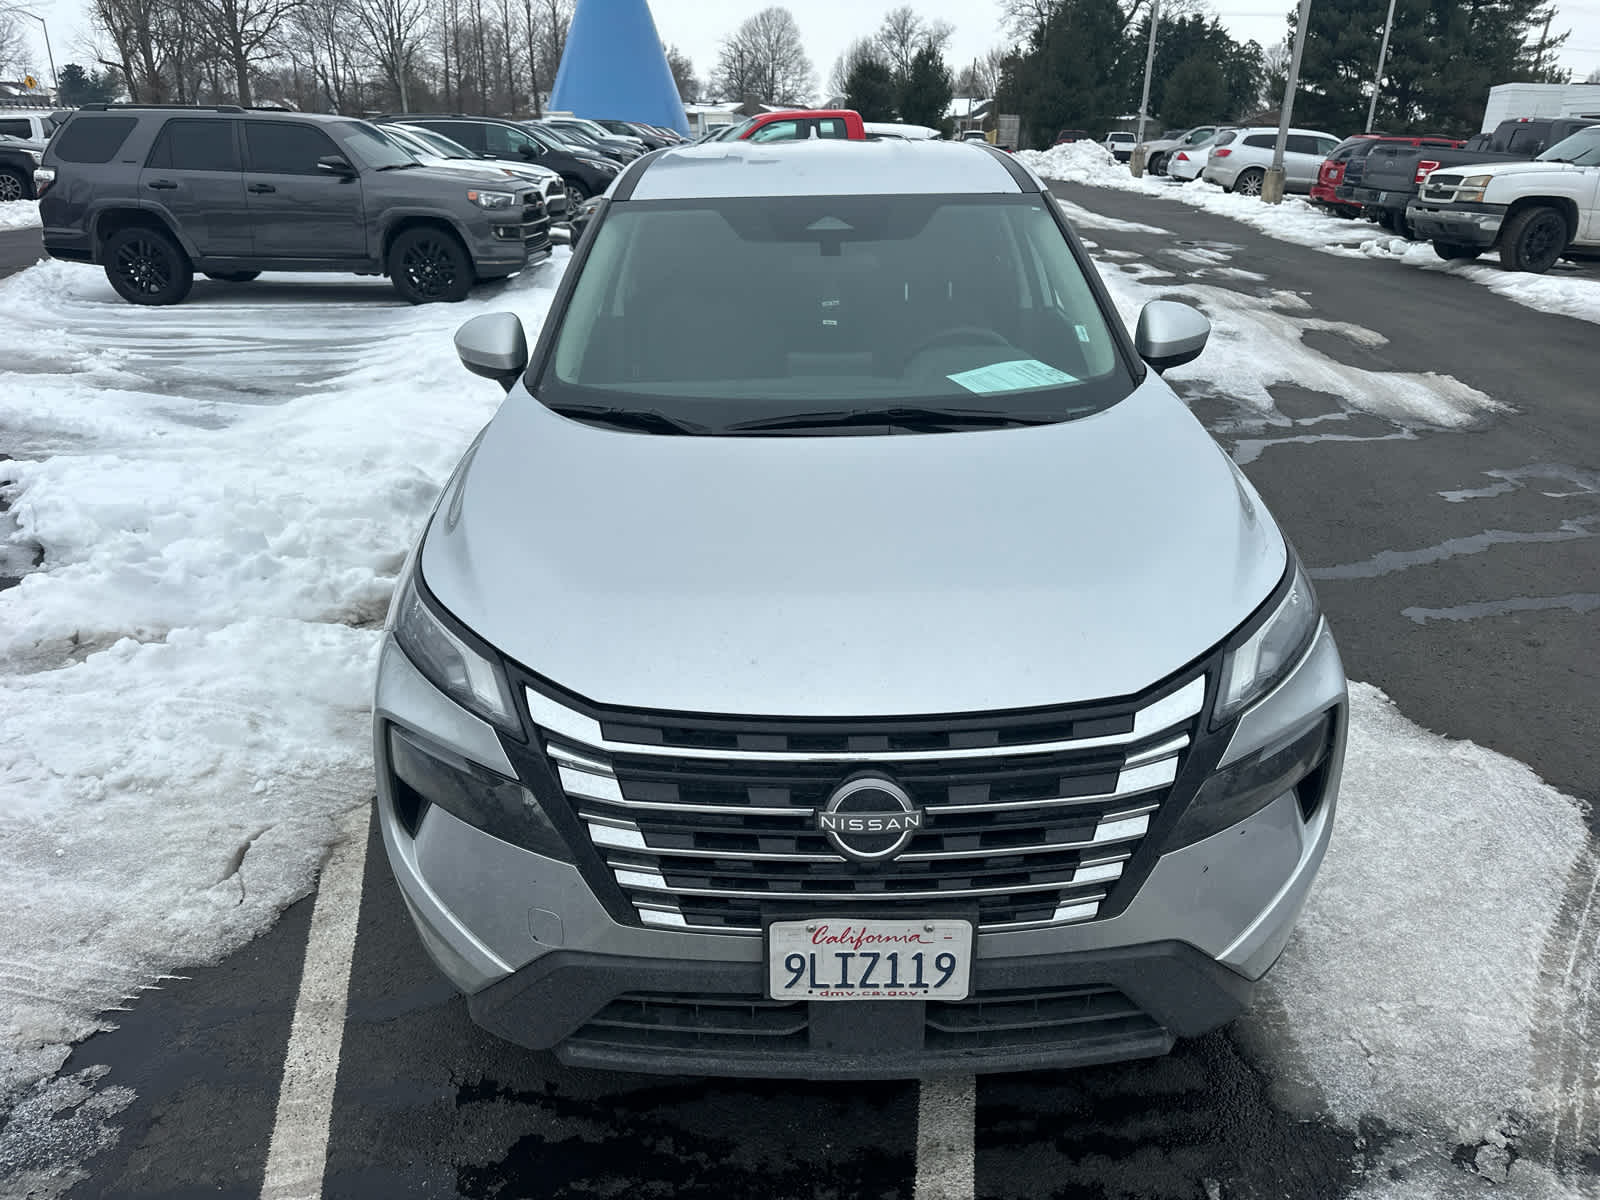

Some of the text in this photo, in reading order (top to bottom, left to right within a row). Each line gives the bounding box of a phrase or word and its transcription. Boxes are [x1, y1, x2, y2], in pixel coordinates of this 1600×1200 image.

[821, 815, 919, 831] NISSAN
[811, 925, 934, 951] California
[784, 952, 957, 989] 9LIZ119
[819, 989, 919, 997] dmv.ca.gov
